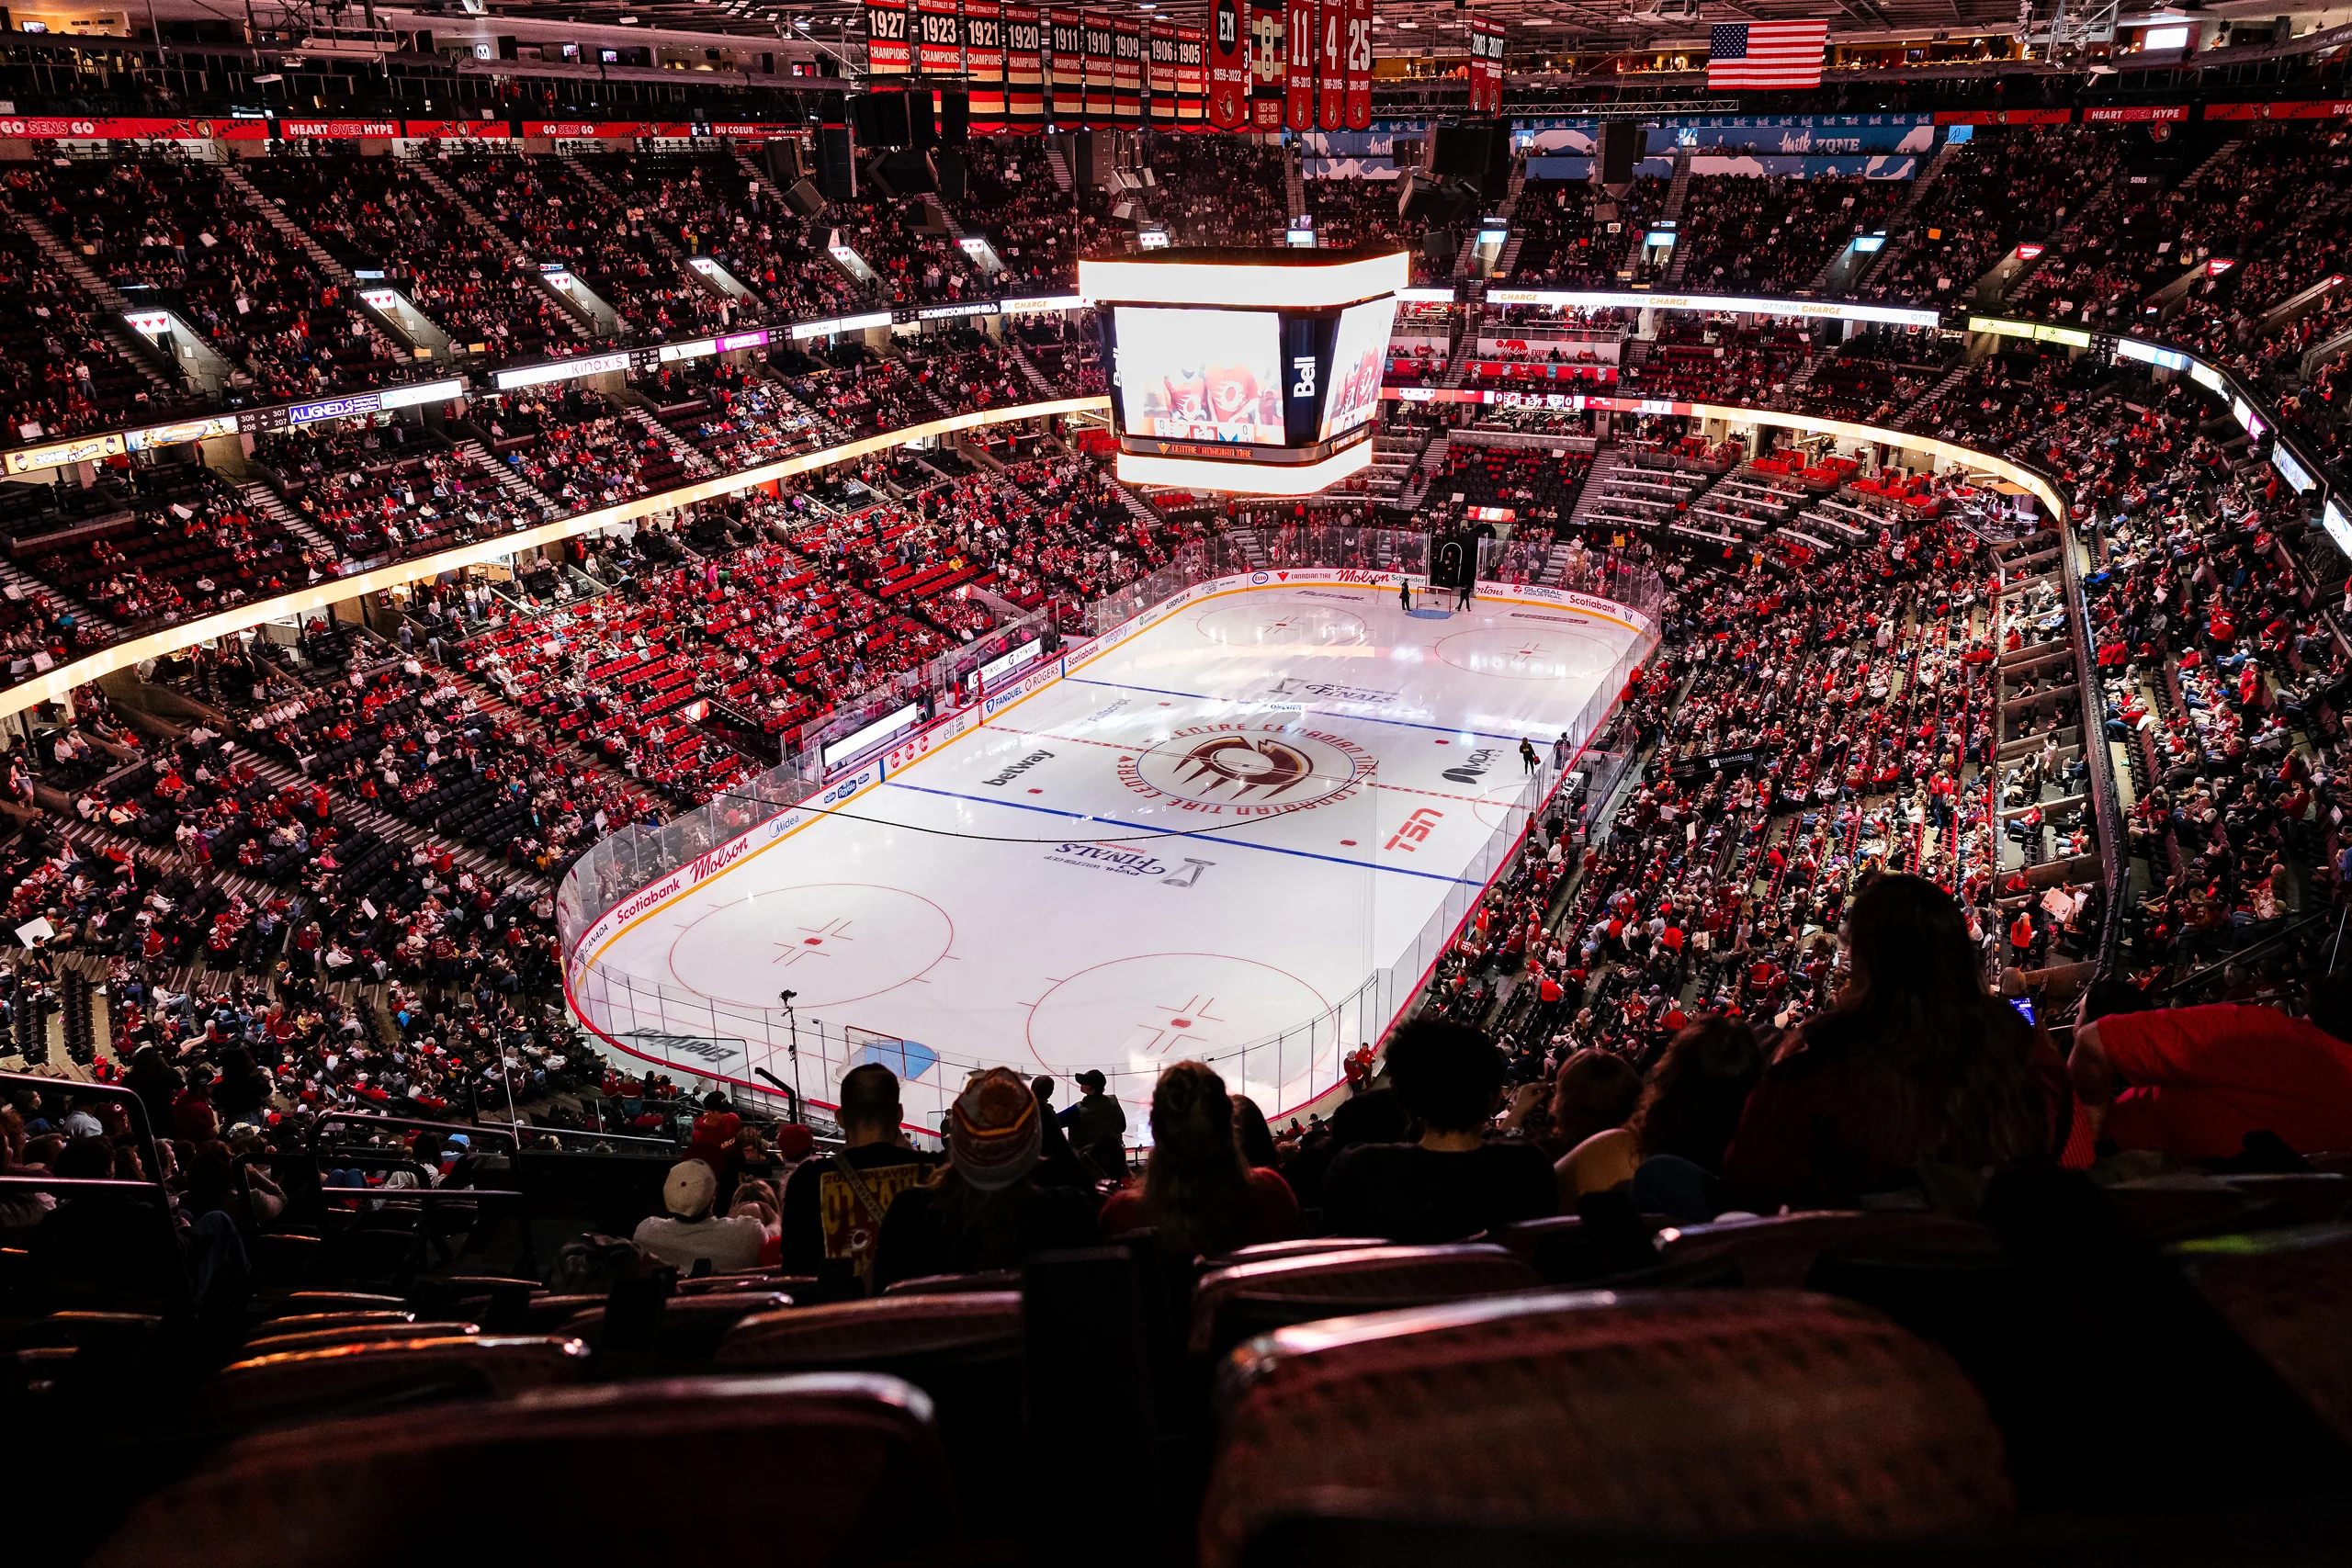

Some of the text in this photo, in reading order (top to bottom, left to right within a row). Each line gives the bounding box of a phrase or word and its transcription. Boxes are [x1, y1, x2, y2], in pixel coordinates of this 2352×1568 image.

[977, 5, 989, 13] STANLEY
[869, 9, 905, 39] 1927
[921, 15, 956, 43] 1923
[1218, 11, 1235, 42] EM
[968, 20, 999, 46] 1921
[1009, 24, 1039, 50] 1920
[1054, 28, 1078, 51] 1911
[1293, 8, 1308, 67] 11
[1087, 31, 1109, 54] 1910
[1115, 35, 1139, 58] 1909
[1151, 39, 1173, 61] 1906
[1261, 15, 1274, 83] 8
[1326, 15, 1338, 71] 4
[1349, 18, 1371, 72] 25
[1472, 33, 1486, 55] 2003
[1488, 36, 1504, 58] 2007
[871, 46, 910, 60] CHAMPIONS
[921, 50, 959, 63] CHAMPIONS
[967, 52, 1002, 65] CHAMPIONS
[1179, 42, 1200, 63] 1905
[1010, 56, 1040, 68] CHAMPIONS
[1054, 58, 1080, 70] CHAMPIONS
[1086, 61, 1112, 72] CHAMPIONS
[1114, 62, 1139, 74] CHAMPIONS
[1151, 66, 1173, 78] CHAMPIONS
[1178, 69, 1201, 80] CHAMPIONS
[1214, 69, 1241, 82] 1959-2022
[2091, 108, 2179, 119] HEART OVER HYPE
[2334, 104, 2345, 114] DU
[1, 120, 95, 135] GO SENS GO
[288, 123, 393, 135] HEART OVER HYPE
[542, 124, 594, 135] GO SENS GO
[715, 126, 727, 134] DU
[729, 126, 754, 134] COEUR
[1815, 138, 1860, 152] ZONE
[1500, 293, 1537, 301] CHARGE
[1649, 297, 1689, 306] CHARGE
[1014, 300, 1047, 310] CHARGE
[1761, 303, 1841, 315] OTTAWA CHARGE
[1293, 356, 1316, 398] Bell
[1566, 398, 1572, 406] 0
[241, 413, 255, 423] 306
[272, 409, 286, 417] 307
[292, 401, 345, 422] ALIGNED
[243, 423, 256, 432] 206
[274, 418, 288, 426] 207
[1171, 445, 1252, 458] CENTRE CANADIAN TIRE
[1336, 569, 1390, 583] Molson
[1524, 586, 1563, 596] GLOBAL
[1524, 592, 1563, 600] INDUSTRIAL
[1166, 594, 1186, 611] AEROPLAN
[1569, 595, 1616, 615] Scotiabank
[227, 632, 240, 641] 104
[1104, 624, 1128, 644] wegovy
[1068, 643, 1100, 667] Scotiabank
[1033, 664, 1058, 686] ROGERS
[995, 686, 1023, 707] FANDUEL
[1305, 685, 1396, 703] FINALS
[1463, 749, 1496, 770] MDA
[1719, 753, 1753, 762] brookstreet
[980, 749, 1056, 786] betway
[1117, 762, 1162, 799] CENTRE
[839, 783, 856, 797] Royale
[1167, 798, 1222, 814] TIRE
[769, 815, 799, 838] Midea
[1384, 807, 1444, 852] TSN
[1095, 841, 1147, 854] Scotiabank
[690, 837, 749, 883] Molson
[1055, 842, 1166, 874] FINALS
[617, 878, 681, 925] Scotiabank
[583, 923, 608, 953] CANADA
